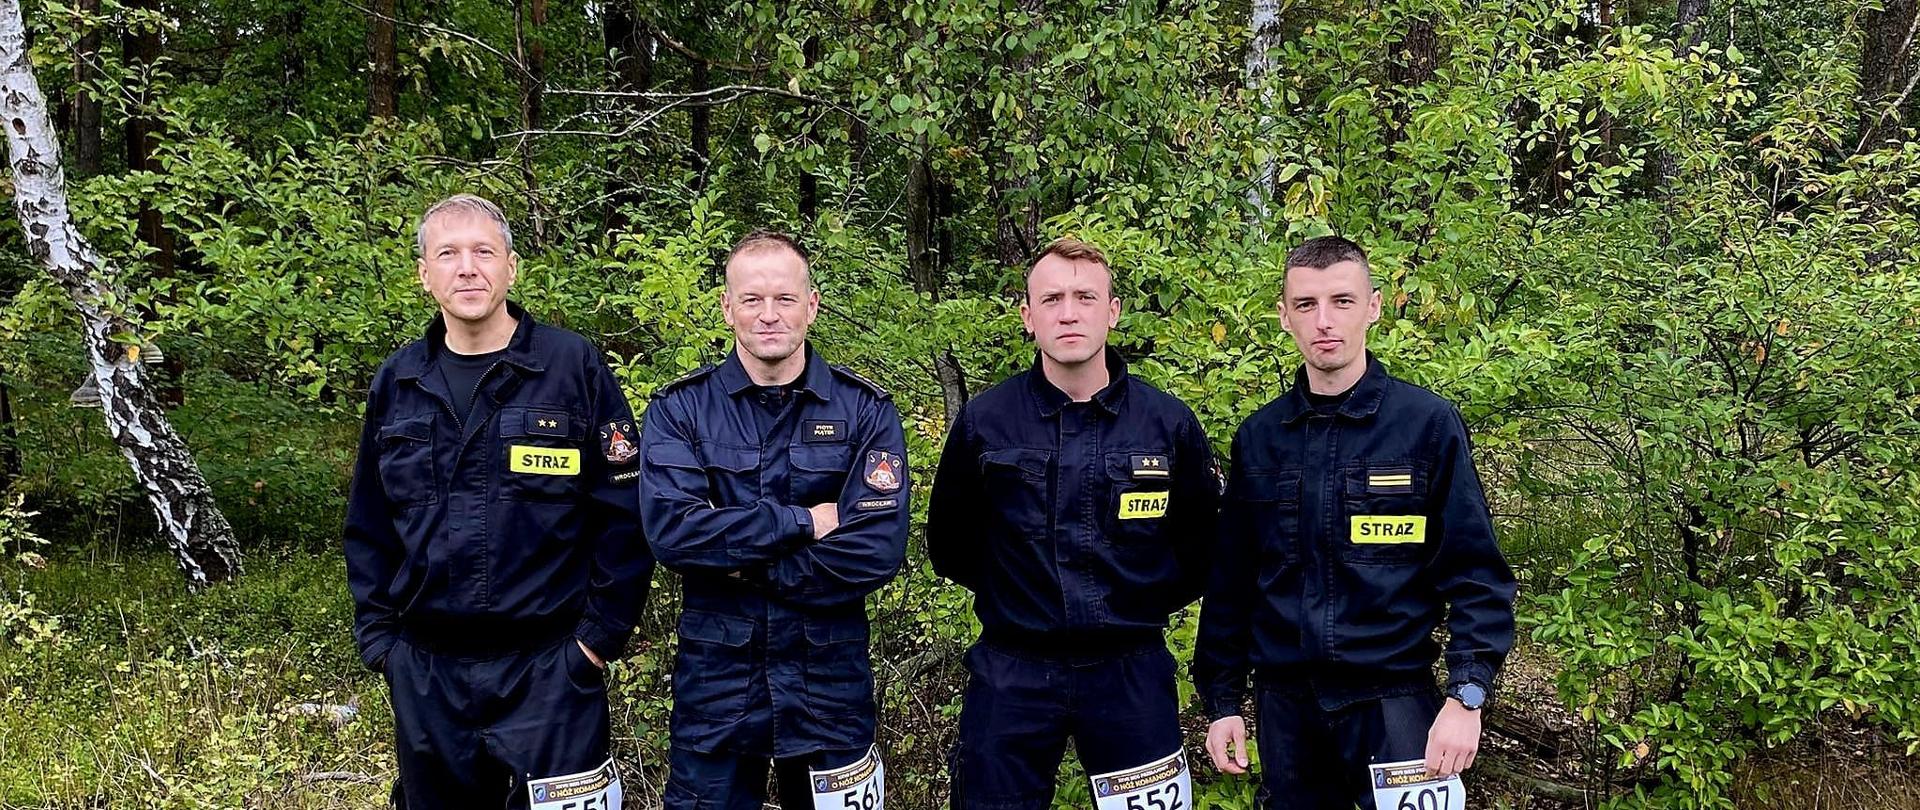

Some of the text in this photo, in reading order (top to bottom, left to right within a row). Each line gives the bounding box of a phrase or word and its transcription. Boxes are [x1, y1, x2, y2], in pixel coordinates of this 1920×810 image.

[844, 776, 880, 810] 561
[1126, 782, 1183, 810] 552
[1397, 786, 1449, 810] 607
